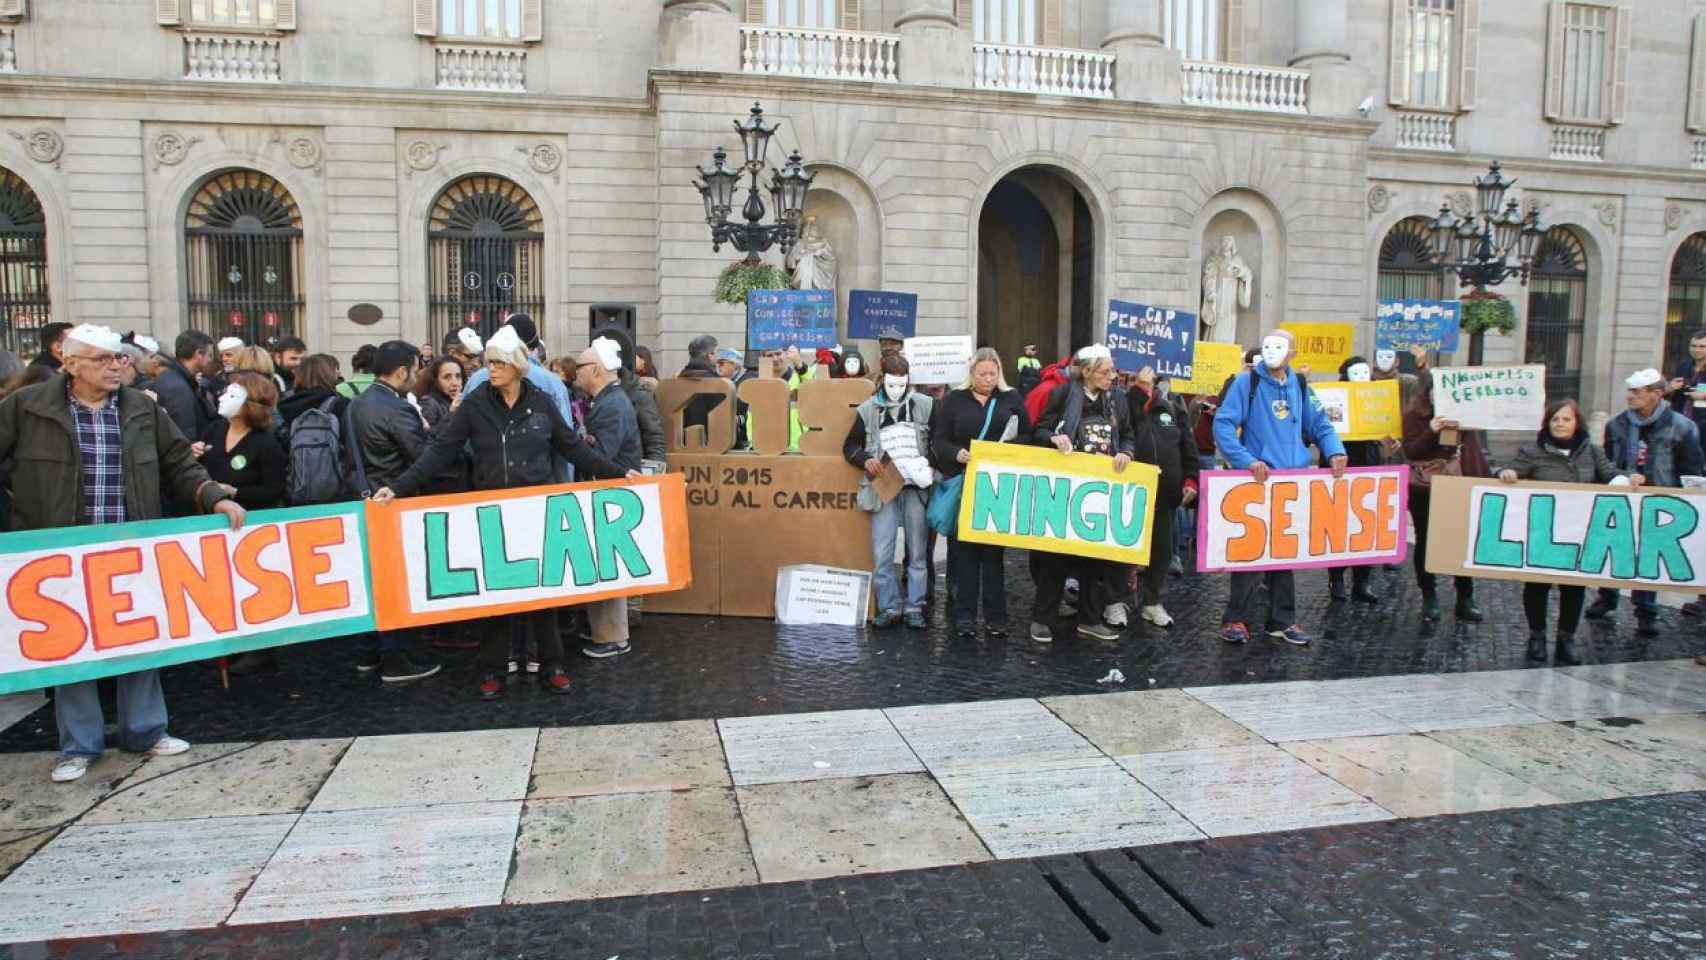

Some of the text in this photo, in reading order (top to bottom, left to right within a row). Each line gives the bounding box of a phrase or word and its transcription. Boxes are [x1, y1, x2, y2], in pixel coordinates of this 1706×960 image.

[1107, 310, 1174, 340] PERSONA
[1145, 306, 1176, 325] CAP
[1107, 333, 1157, 356] SENSE
[1180, 330, 1190, 352] !
[1156, 359, 1193, 379] LLAR
[722, 467, 773, 485] 2015
[686, 486, 720, 507] GÚ
[731, 491, 761, 508] AL
[971, 471, 1148, 547] NINGÚ
[1221, 475, 1399, 563] SENSE
[424, 487, 652, 602] LLAR
[1473, 492, 1699, 582] LLAR
[7, 516, 353, 662] SENSE
